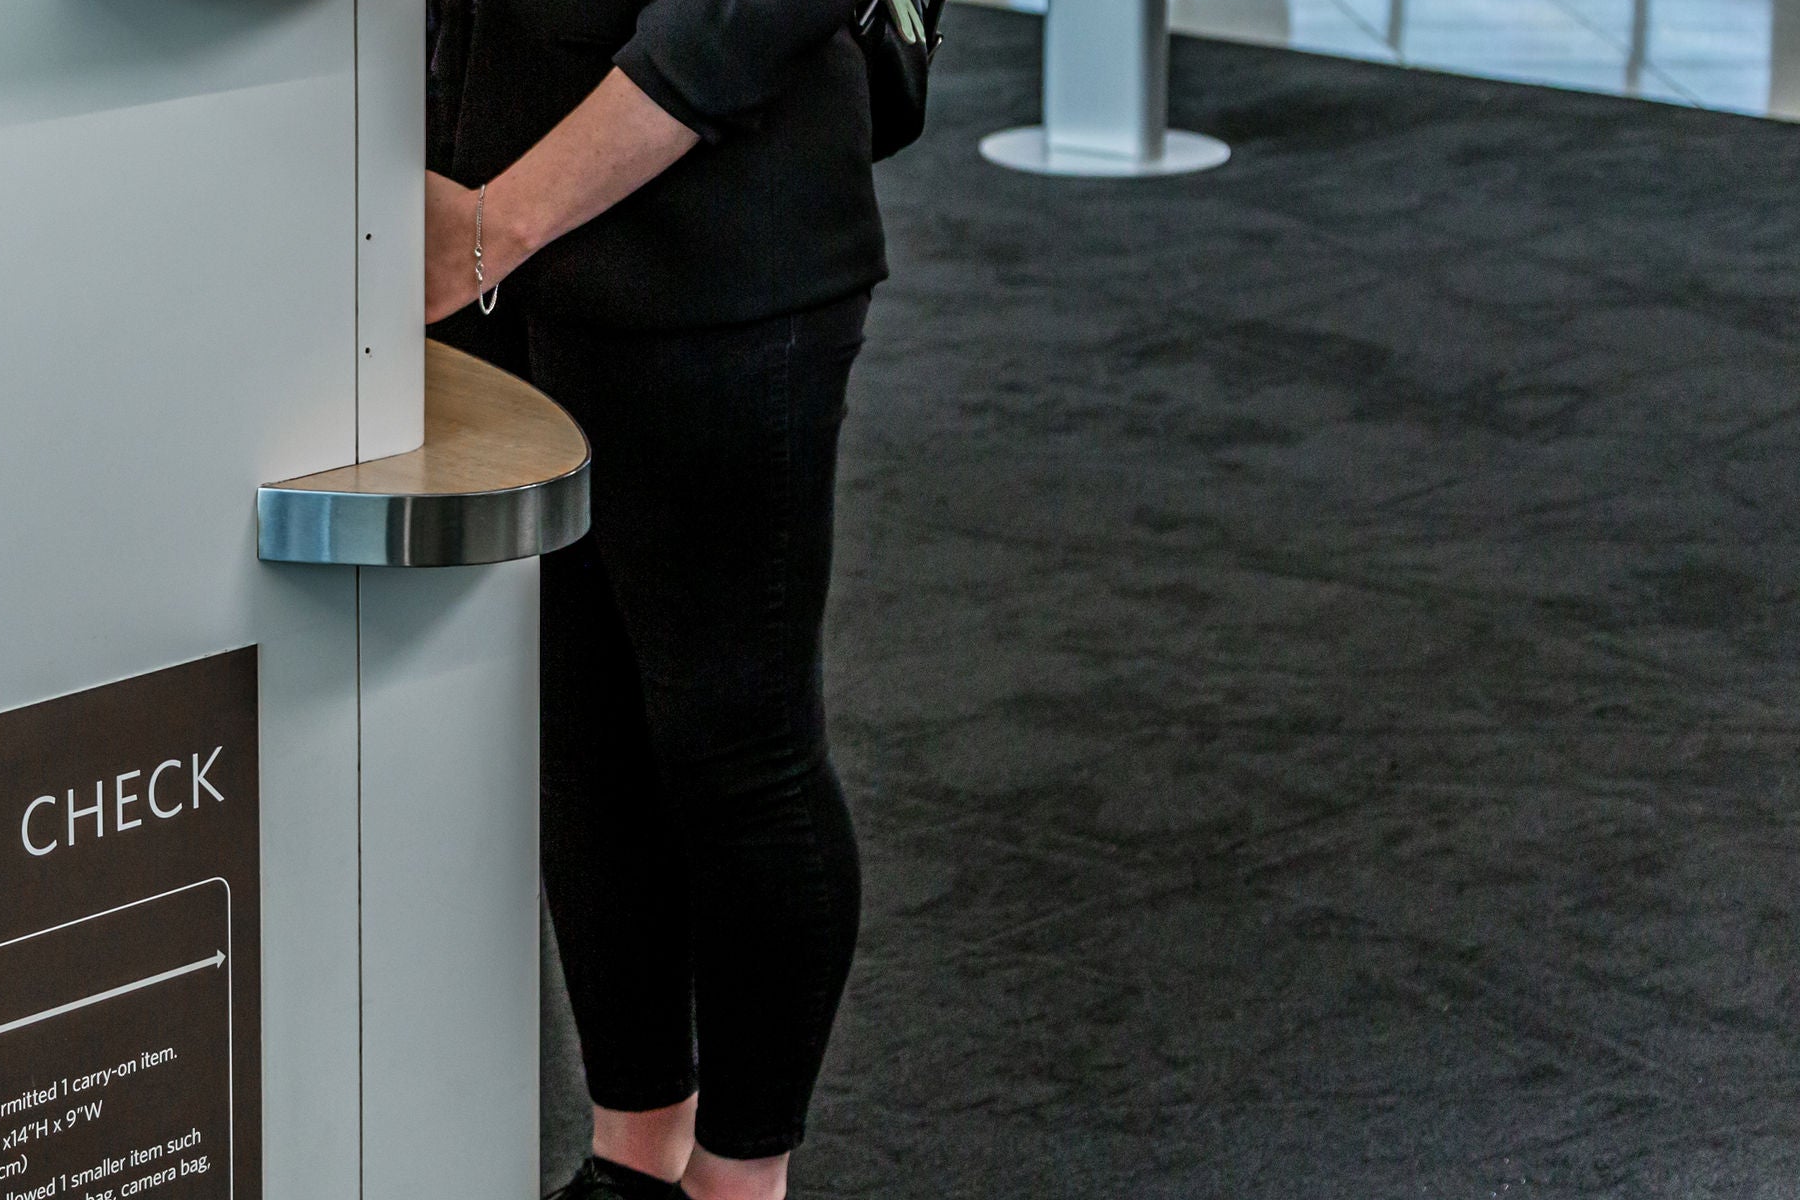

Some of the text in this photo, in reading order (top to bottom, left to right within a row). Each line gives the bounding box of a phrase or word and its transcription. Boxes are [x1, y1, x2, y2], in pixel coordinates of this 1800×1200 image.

[21, 746, 226, 857] CHECK
[61, 1078, 68, 1096] 1
[72, 1060, 137, 1092] carry-on
[141, 1047, 178, 1070] item.
[53, 1118, 63, 1135] x
[66, 1099, 104, 1129] 9"W
[60, 1174, 66, 1192] 1
[71, 1157, 126, 1188] smaller
[130, 1144, 163, 1168] item
[167, 1128, 202, 1154] such
[121, 1166, 177, 1197] camera
[180, 1154, 211, 1178] bag,
